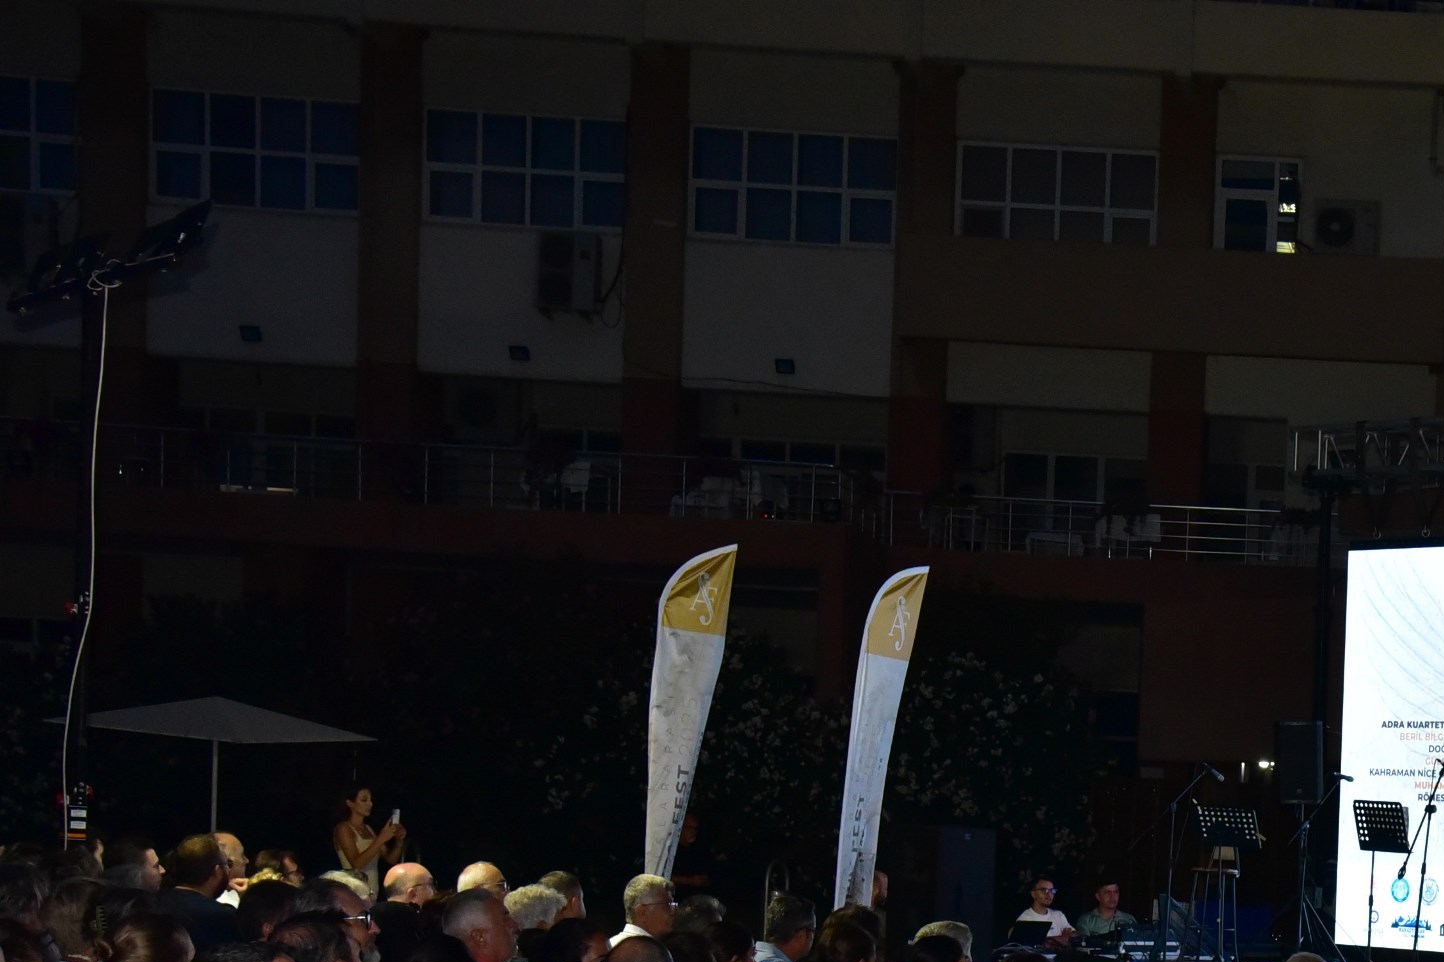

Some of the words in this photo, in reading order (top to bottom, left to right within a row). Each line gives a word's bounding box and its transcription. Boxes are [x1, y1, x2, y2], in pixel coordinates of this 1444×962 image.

[1381, 721, 1404, 729] ADRA
[1406, 721, 1444, 729] KUARTET
[1399, 731, 1423, 741] BERİL
[1369, 768, 1416, 778] KAHRAMAN
